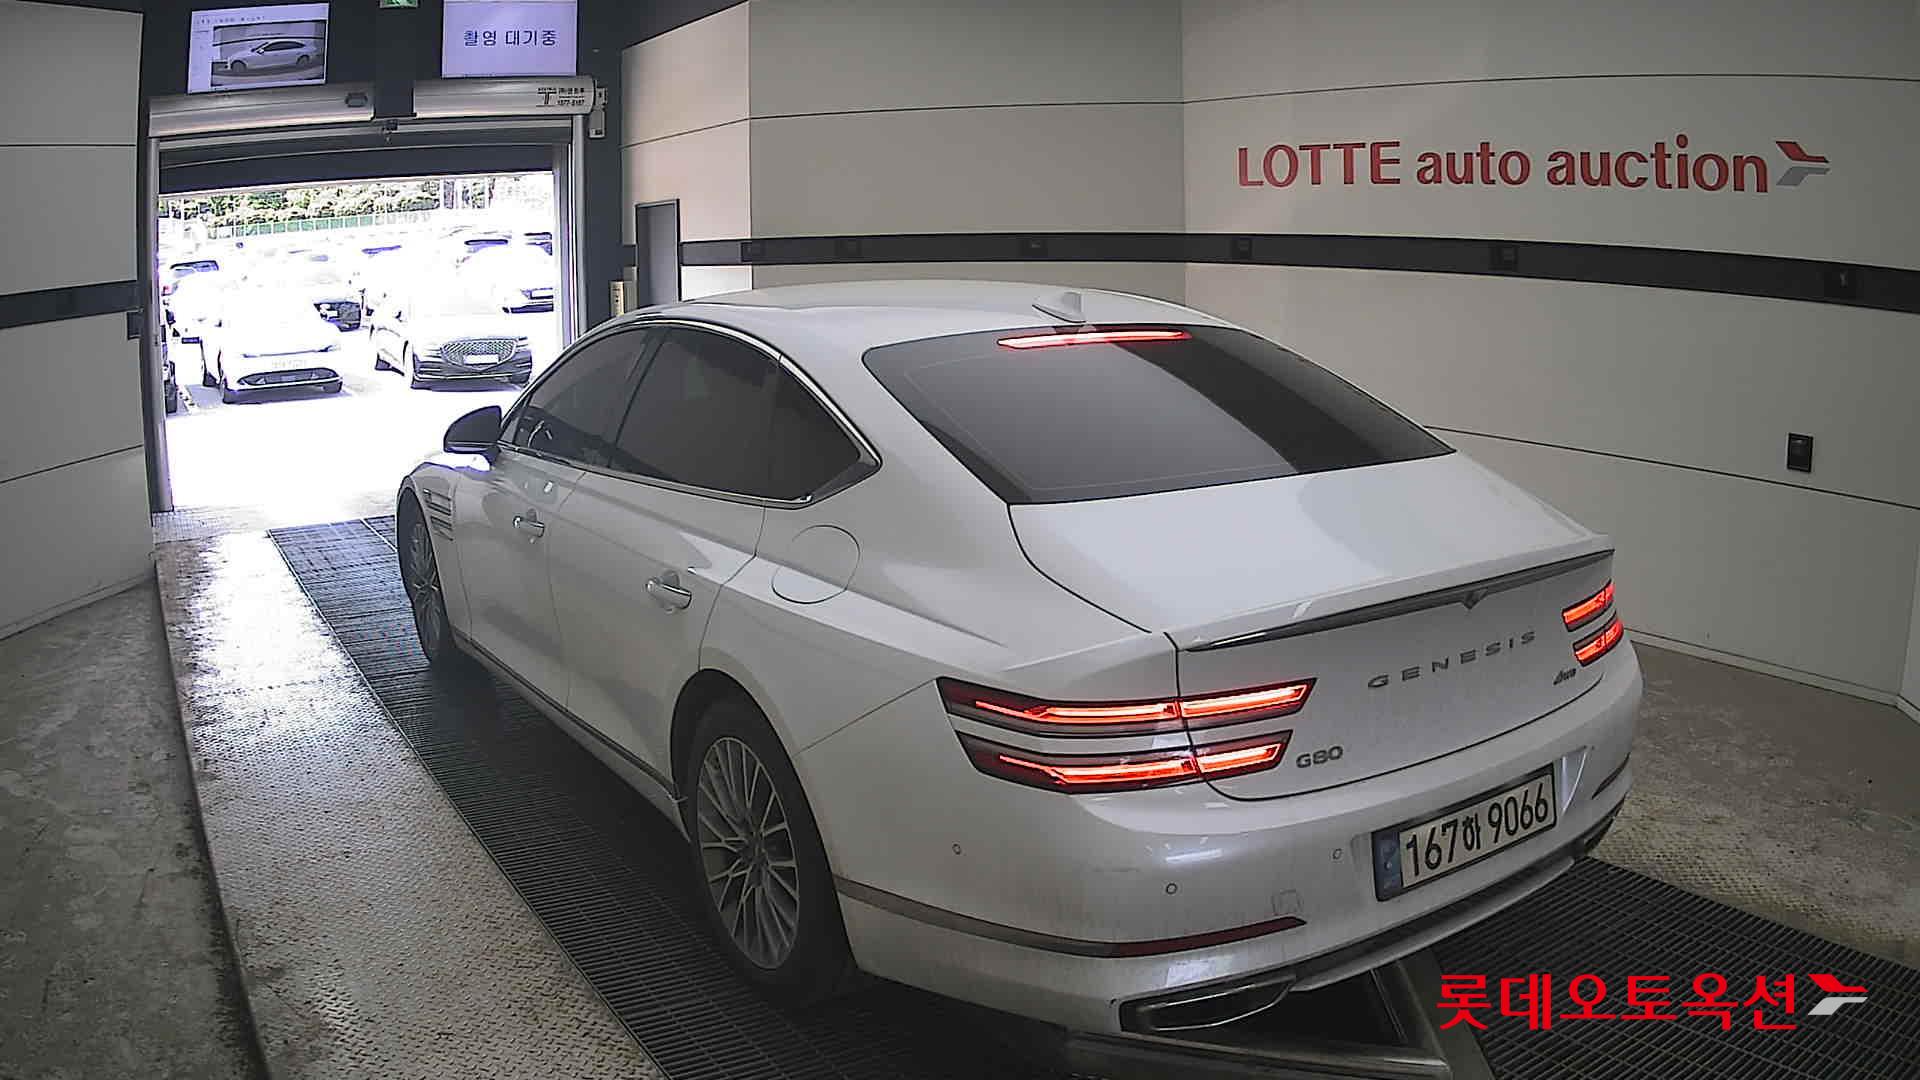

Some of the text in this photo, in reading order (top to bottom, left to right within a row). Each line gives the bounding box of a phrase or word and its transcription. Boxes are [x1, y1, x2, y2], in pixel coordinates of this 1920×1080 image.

[504, 29, 557, 47] 대기중
[1237, 133, 1769, 193] LOTTE auto auction
[1367, 630, 1537, 689] GENESIS
[1295, 745, 1344, 769] G80
[1405, 782, 1549, 878] 167하 9066
